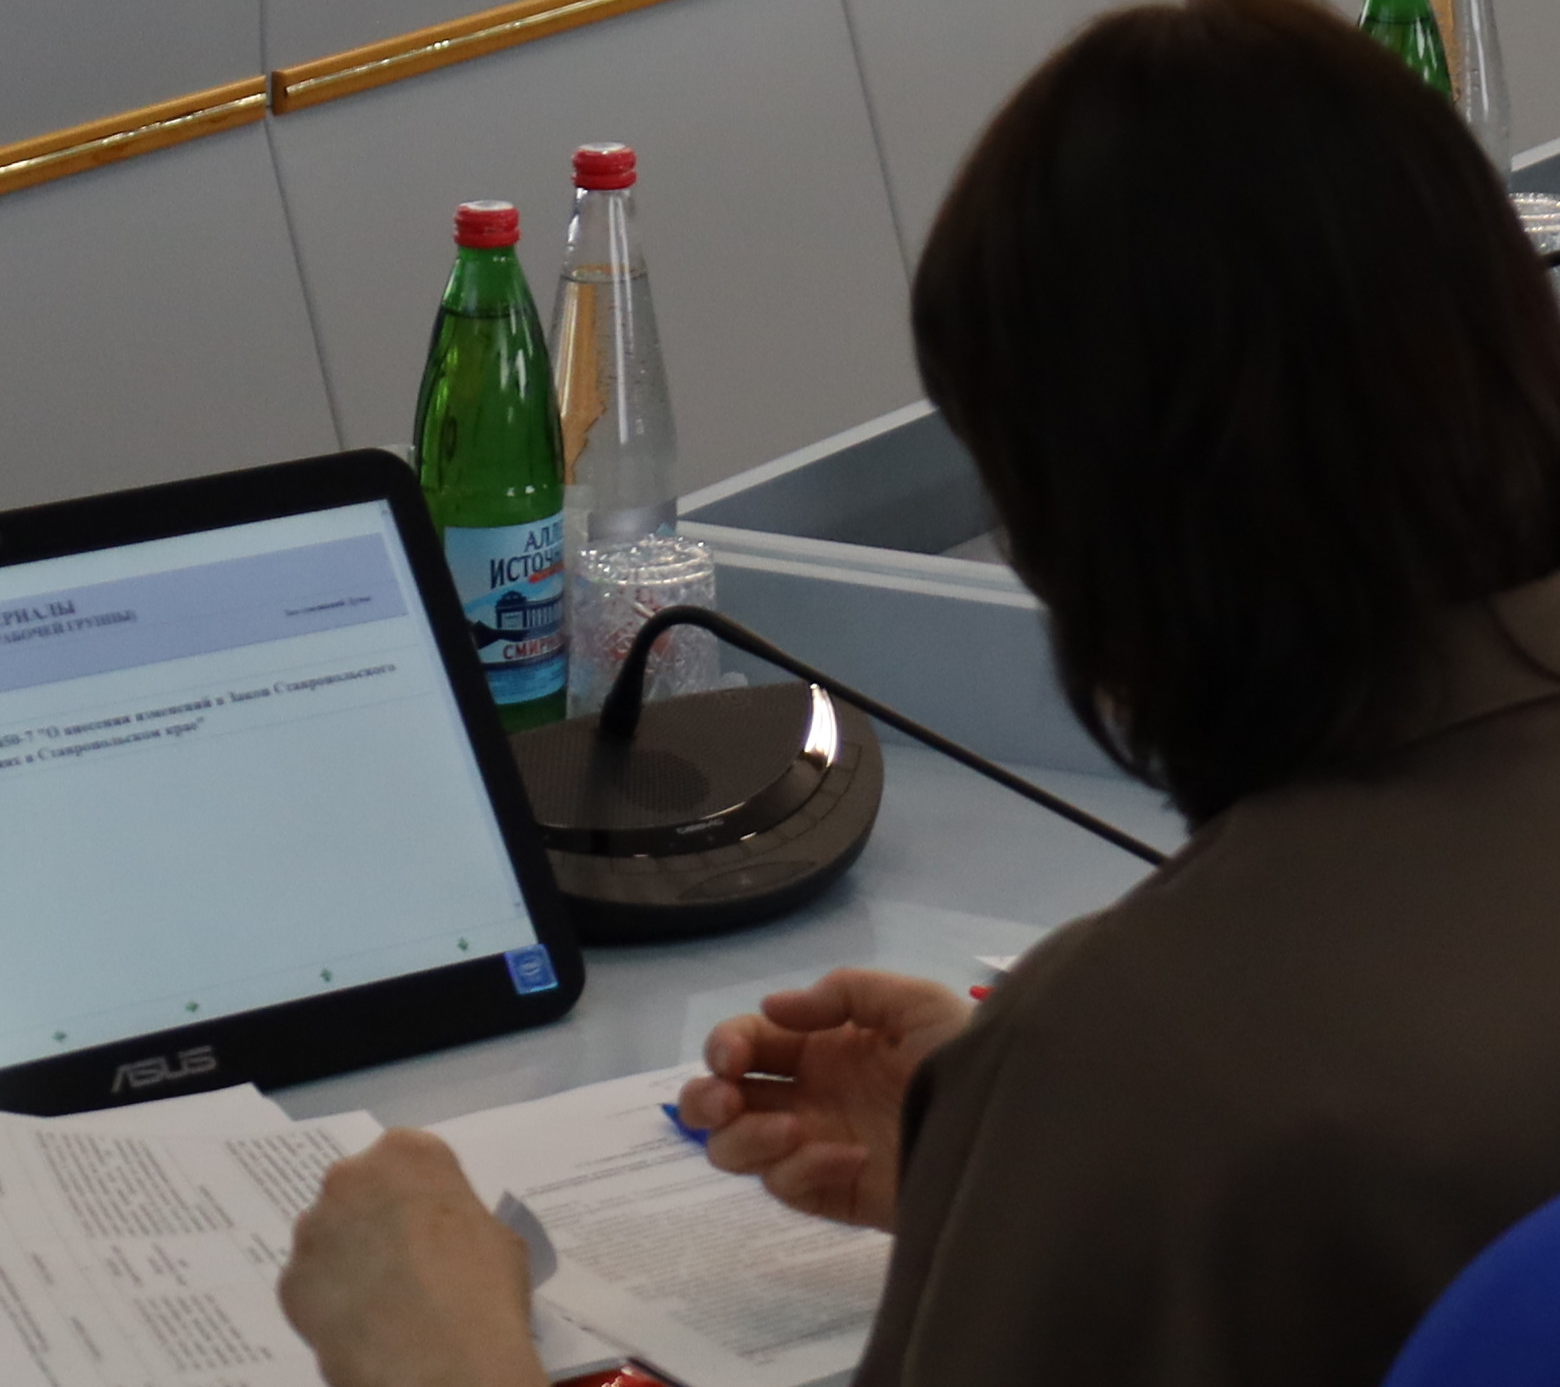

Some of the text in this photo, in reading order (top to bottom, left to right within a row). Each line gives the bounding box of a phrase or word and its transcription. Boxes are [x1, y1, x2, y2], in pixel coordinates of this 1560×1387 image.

[273, 661, 397, 698] Ставропольского
[37, 726, 161, 761] Ставропольском
[111, 1045, 217, 1093] ASUS
